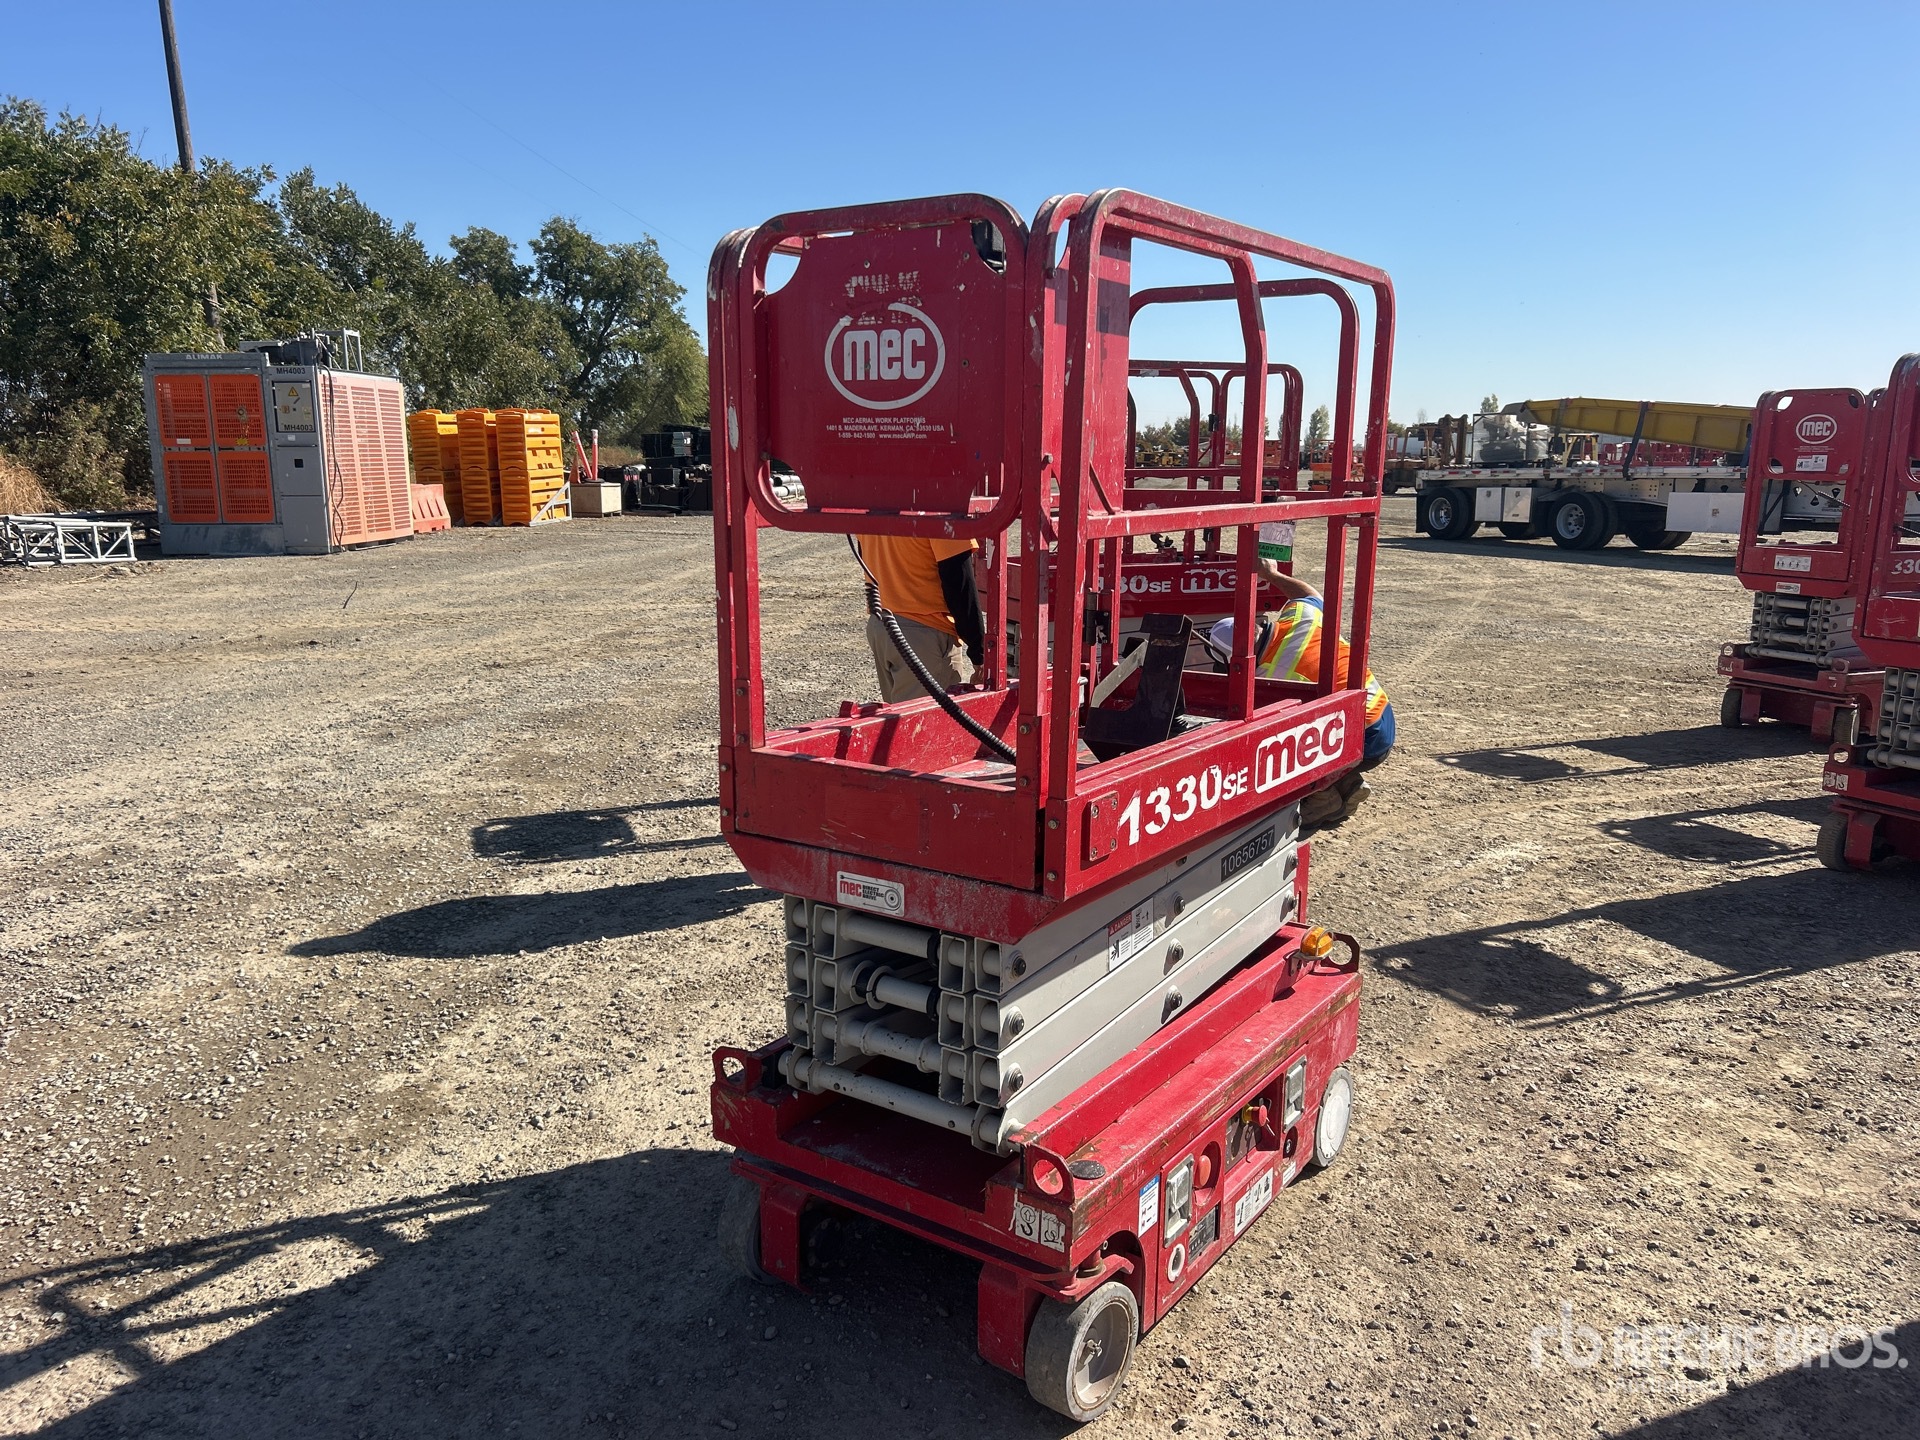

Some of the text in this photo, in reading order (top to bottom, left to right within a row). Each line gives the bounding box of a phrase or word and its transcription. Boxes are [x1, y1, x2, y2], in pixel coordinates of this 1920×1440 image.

[276, 367, 306, 375] MH4003
[843, 328, 926, 381] mec
[1223, 829, 1274, 876] 10656757
